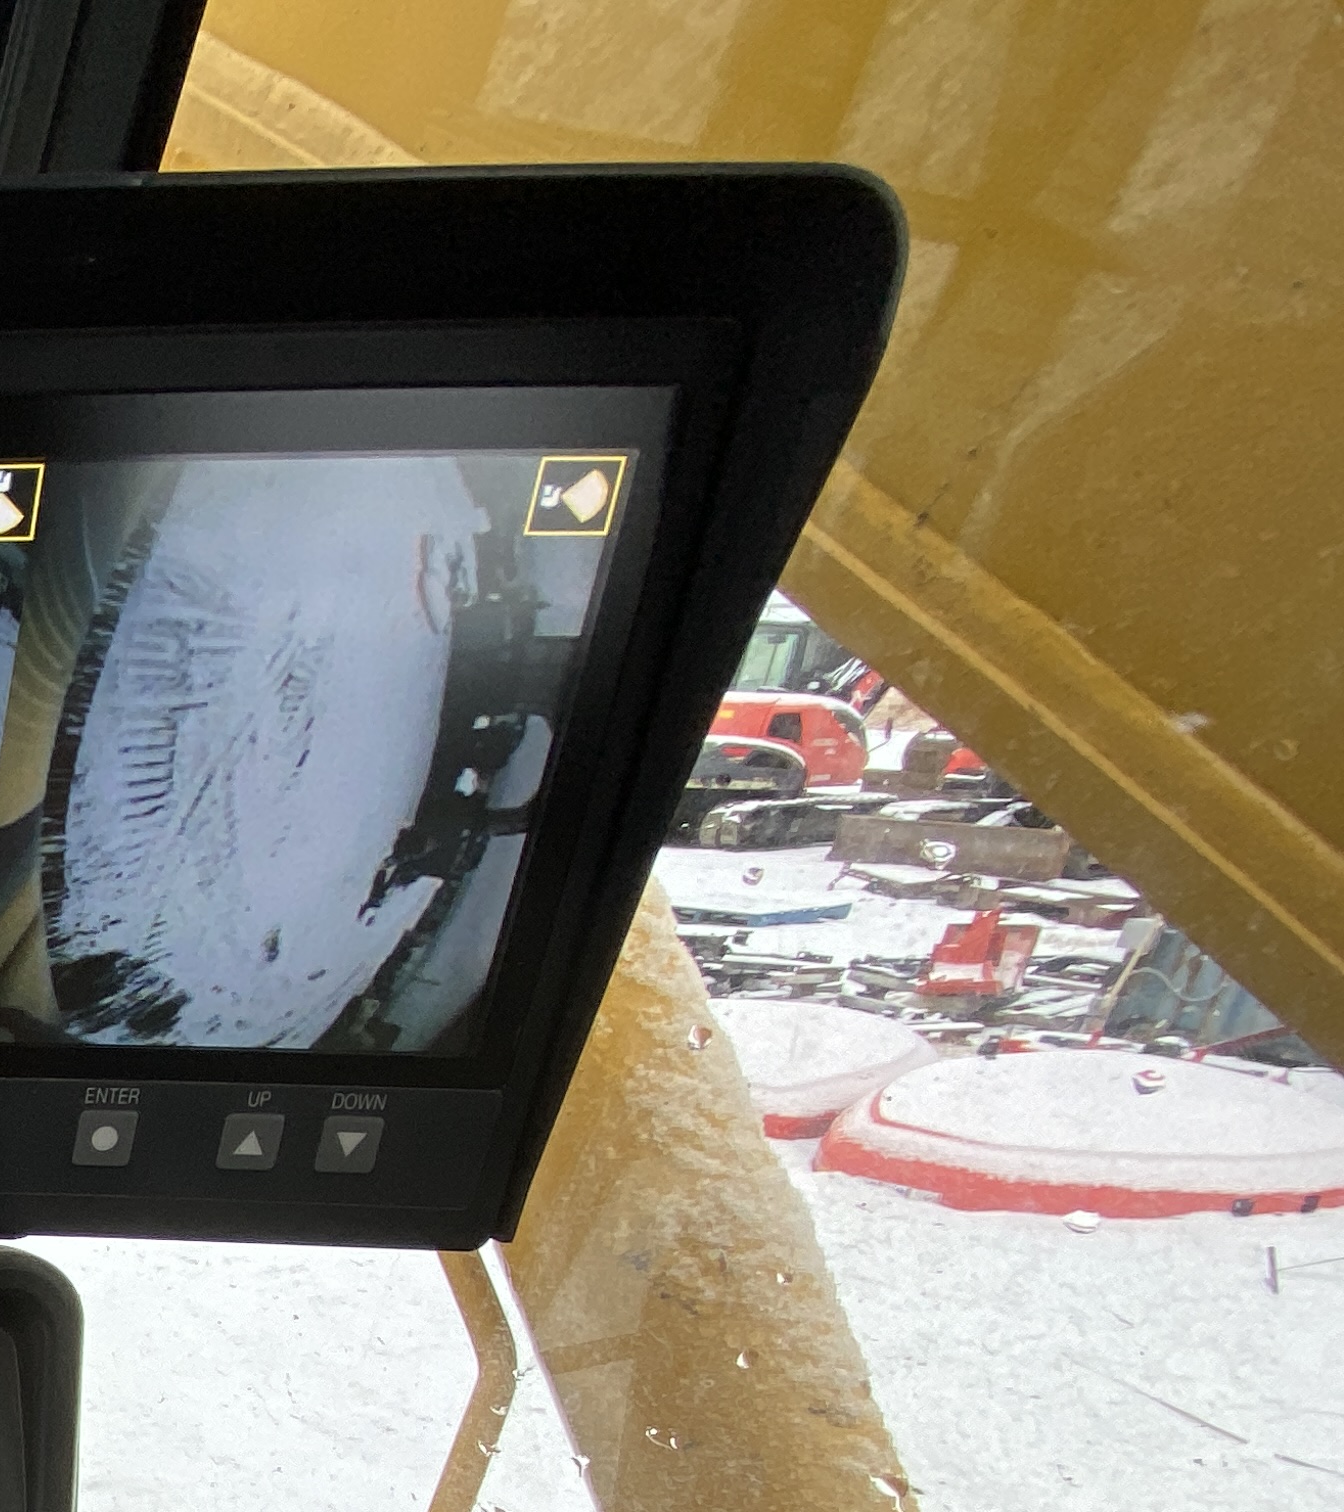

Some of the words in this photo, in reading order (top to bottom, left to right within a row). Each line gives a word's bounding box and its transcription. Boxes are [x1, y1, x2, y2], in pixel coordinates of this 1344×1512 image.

[84, 1087, 141, 1106] ENTER
[247, 1091, 273, 1108] UP
[332, 1093, 387, 1112] DOWN
